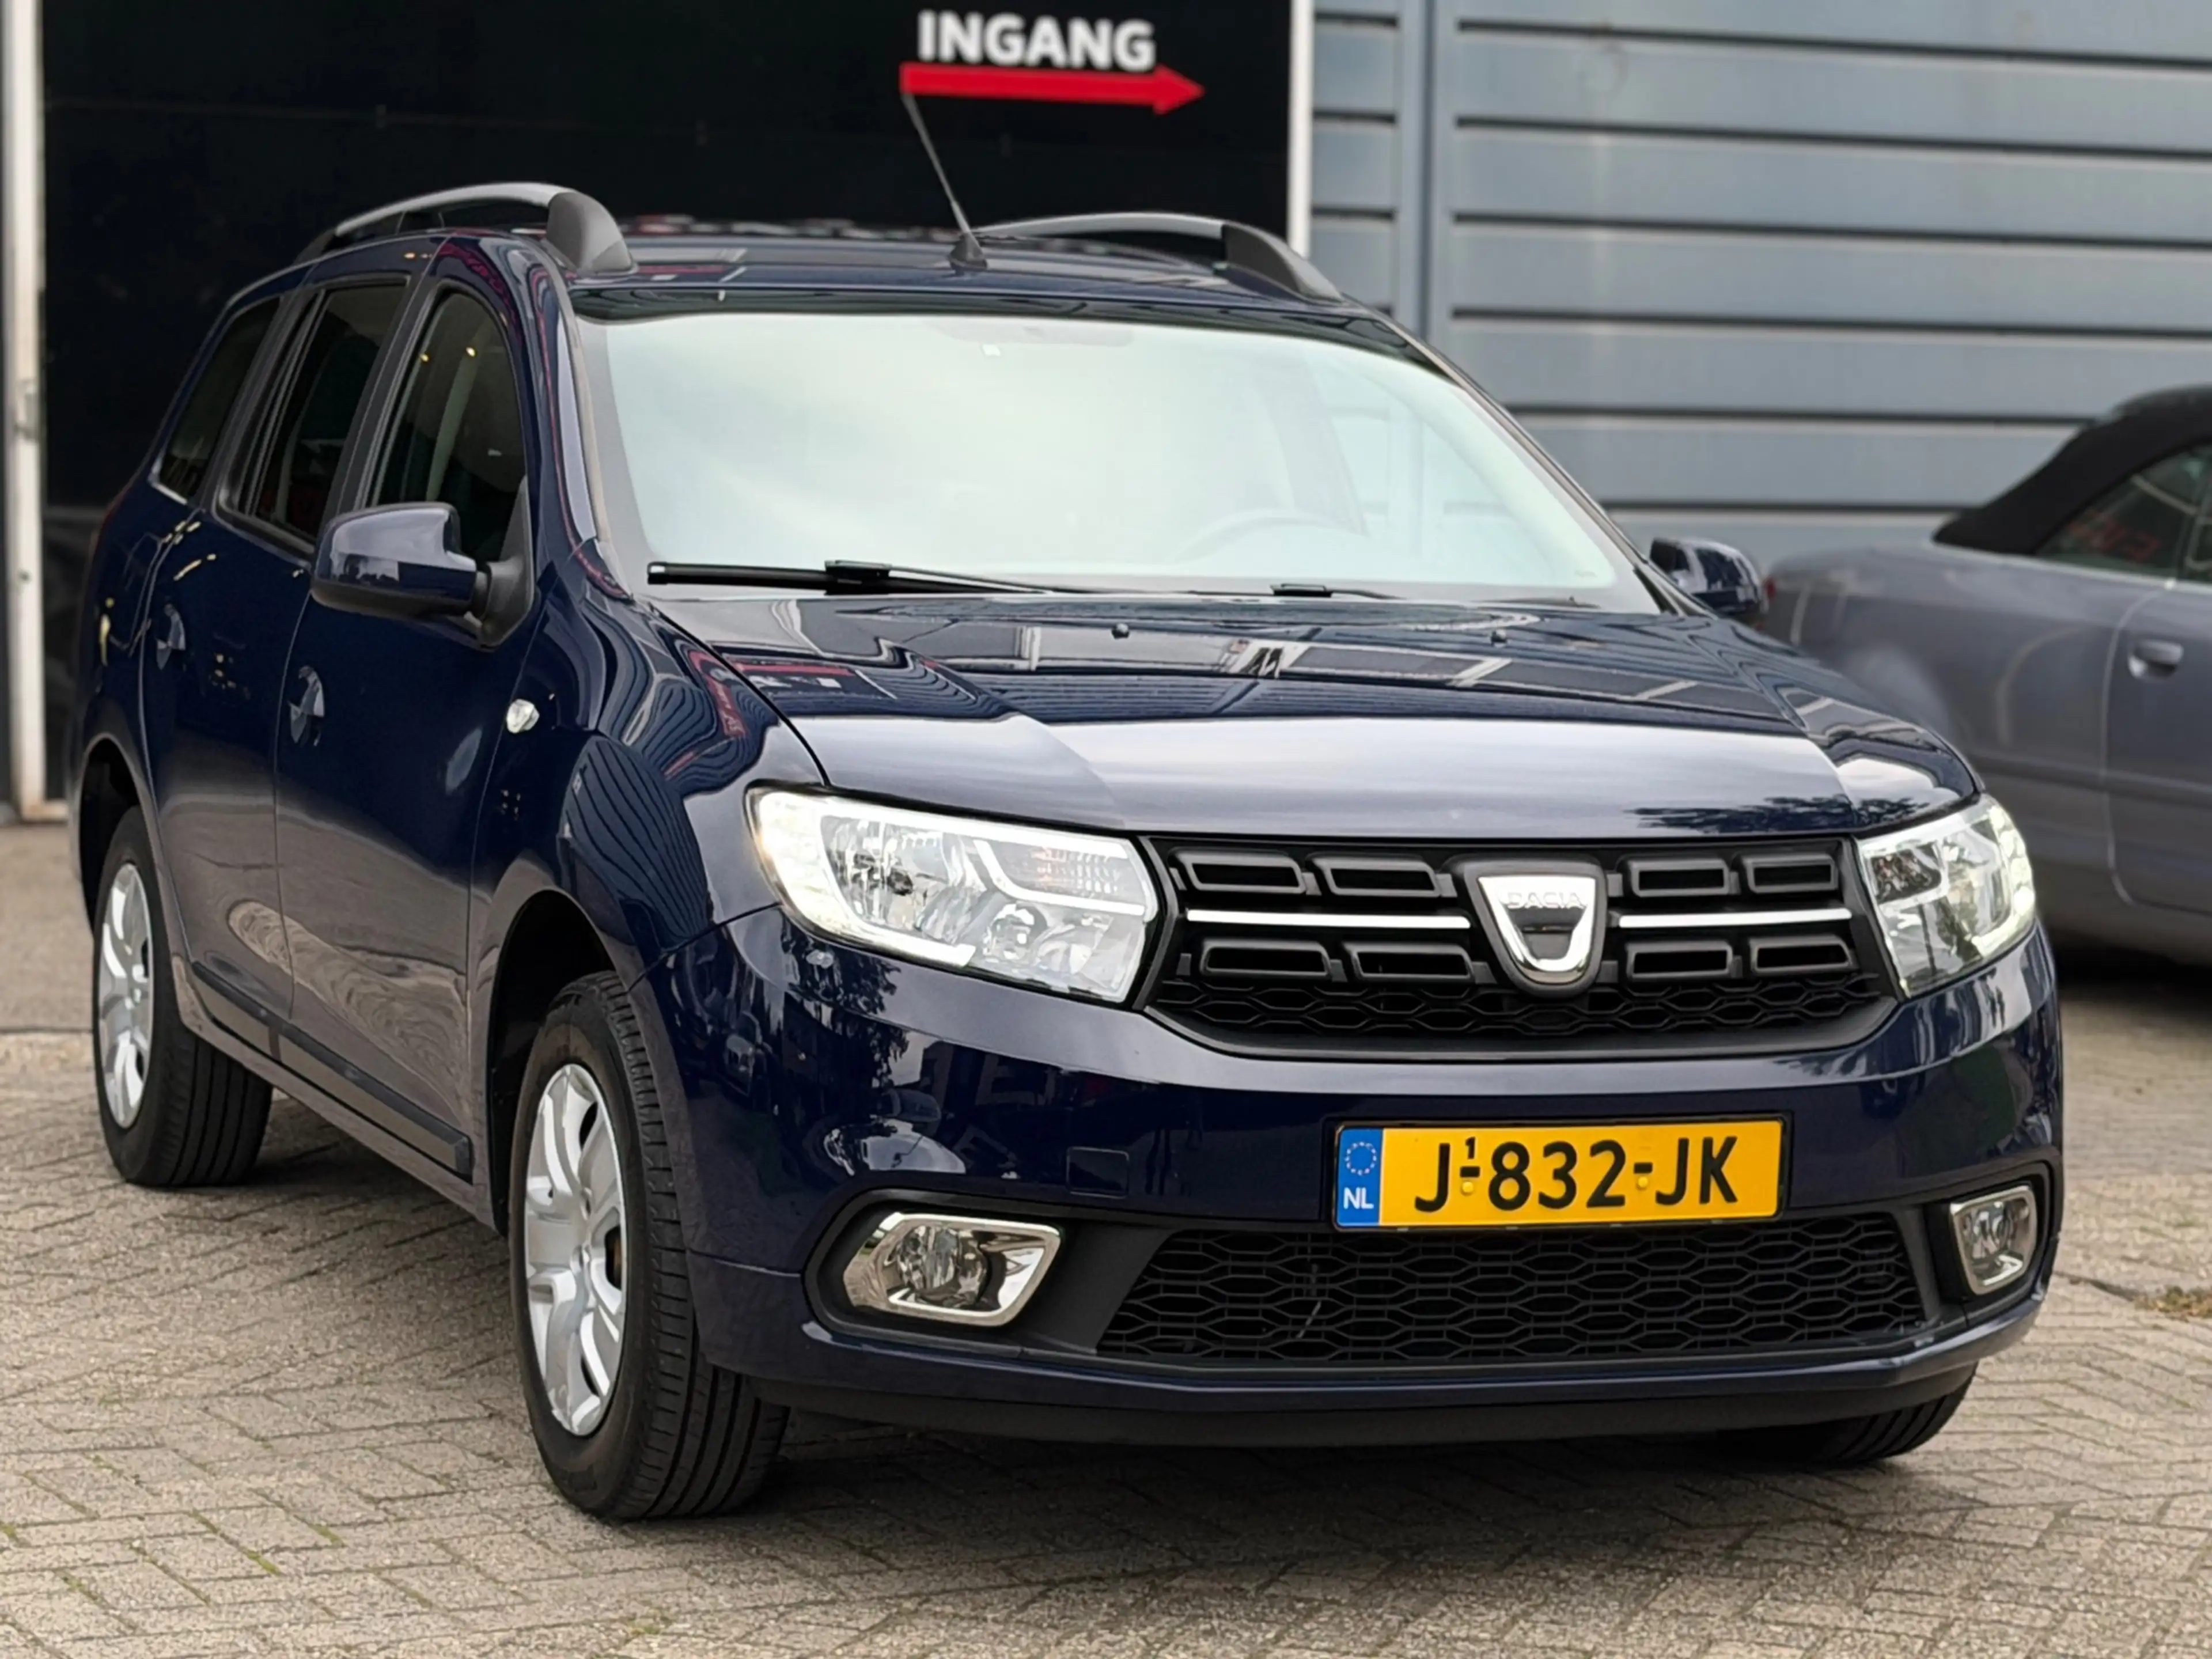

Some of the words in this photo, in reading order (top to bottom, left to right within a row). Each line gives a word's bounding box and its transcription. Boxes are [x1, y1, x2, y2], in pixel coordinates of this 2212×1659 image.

[918, 10, 1156, 72] INGANG
[1507, 892, 1585, 909] DACIA
[1343, 1187, 1374, 1209] NL
